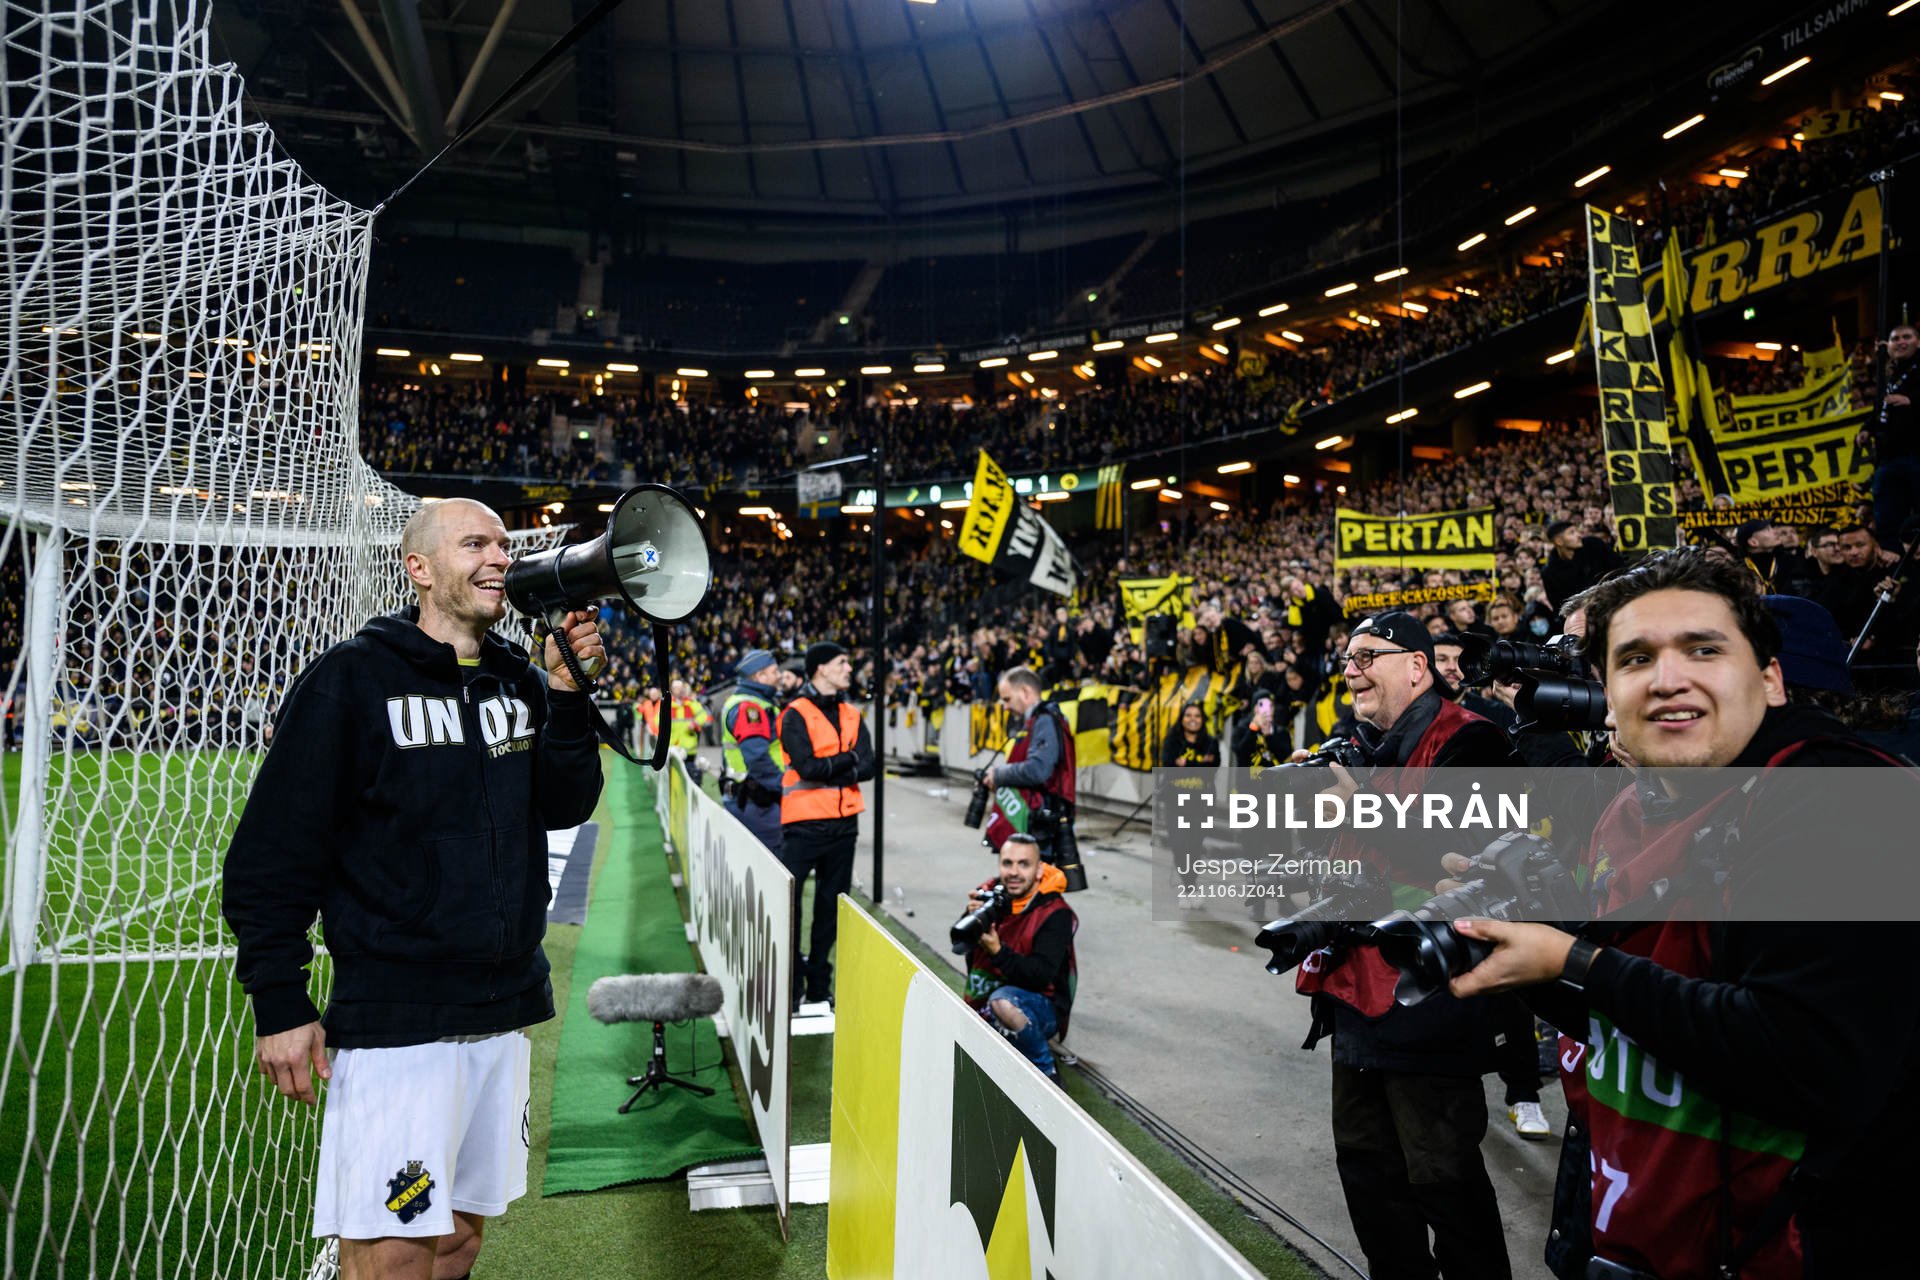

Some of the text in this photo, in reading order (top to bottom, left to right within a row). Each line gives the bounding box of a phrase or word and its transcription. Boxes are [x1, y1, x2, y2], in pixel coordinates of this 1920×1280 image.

[1781, 0, 1870, 50] TILLSAMM
[1725, 437, 1876, 494] PERTA
[1340, 514, 1493, 552] PERTAN
